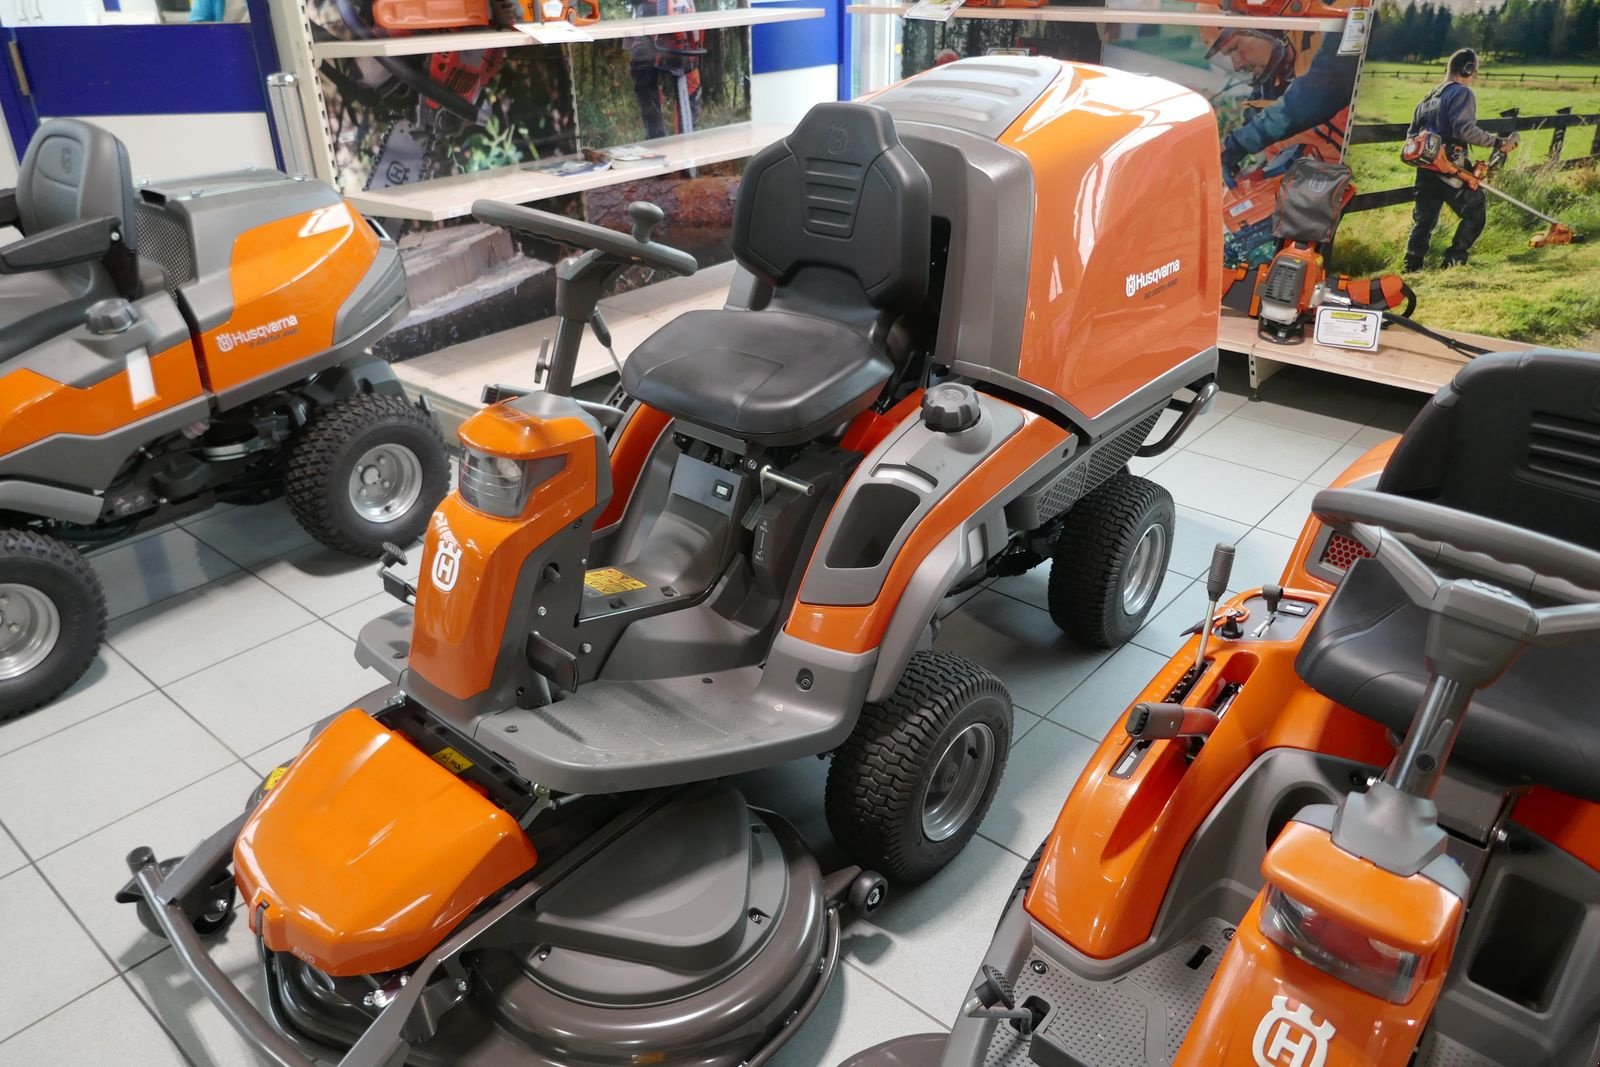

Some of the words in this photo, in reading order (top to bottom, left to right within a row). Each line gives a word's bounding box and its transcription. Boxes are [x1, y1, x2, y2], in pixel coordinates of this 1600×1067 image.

[1135, 259, 1180, 291] Husqvarna
[231, 315, 299, 346] Husqvarna
[292, 945, 316, 964] AWD
